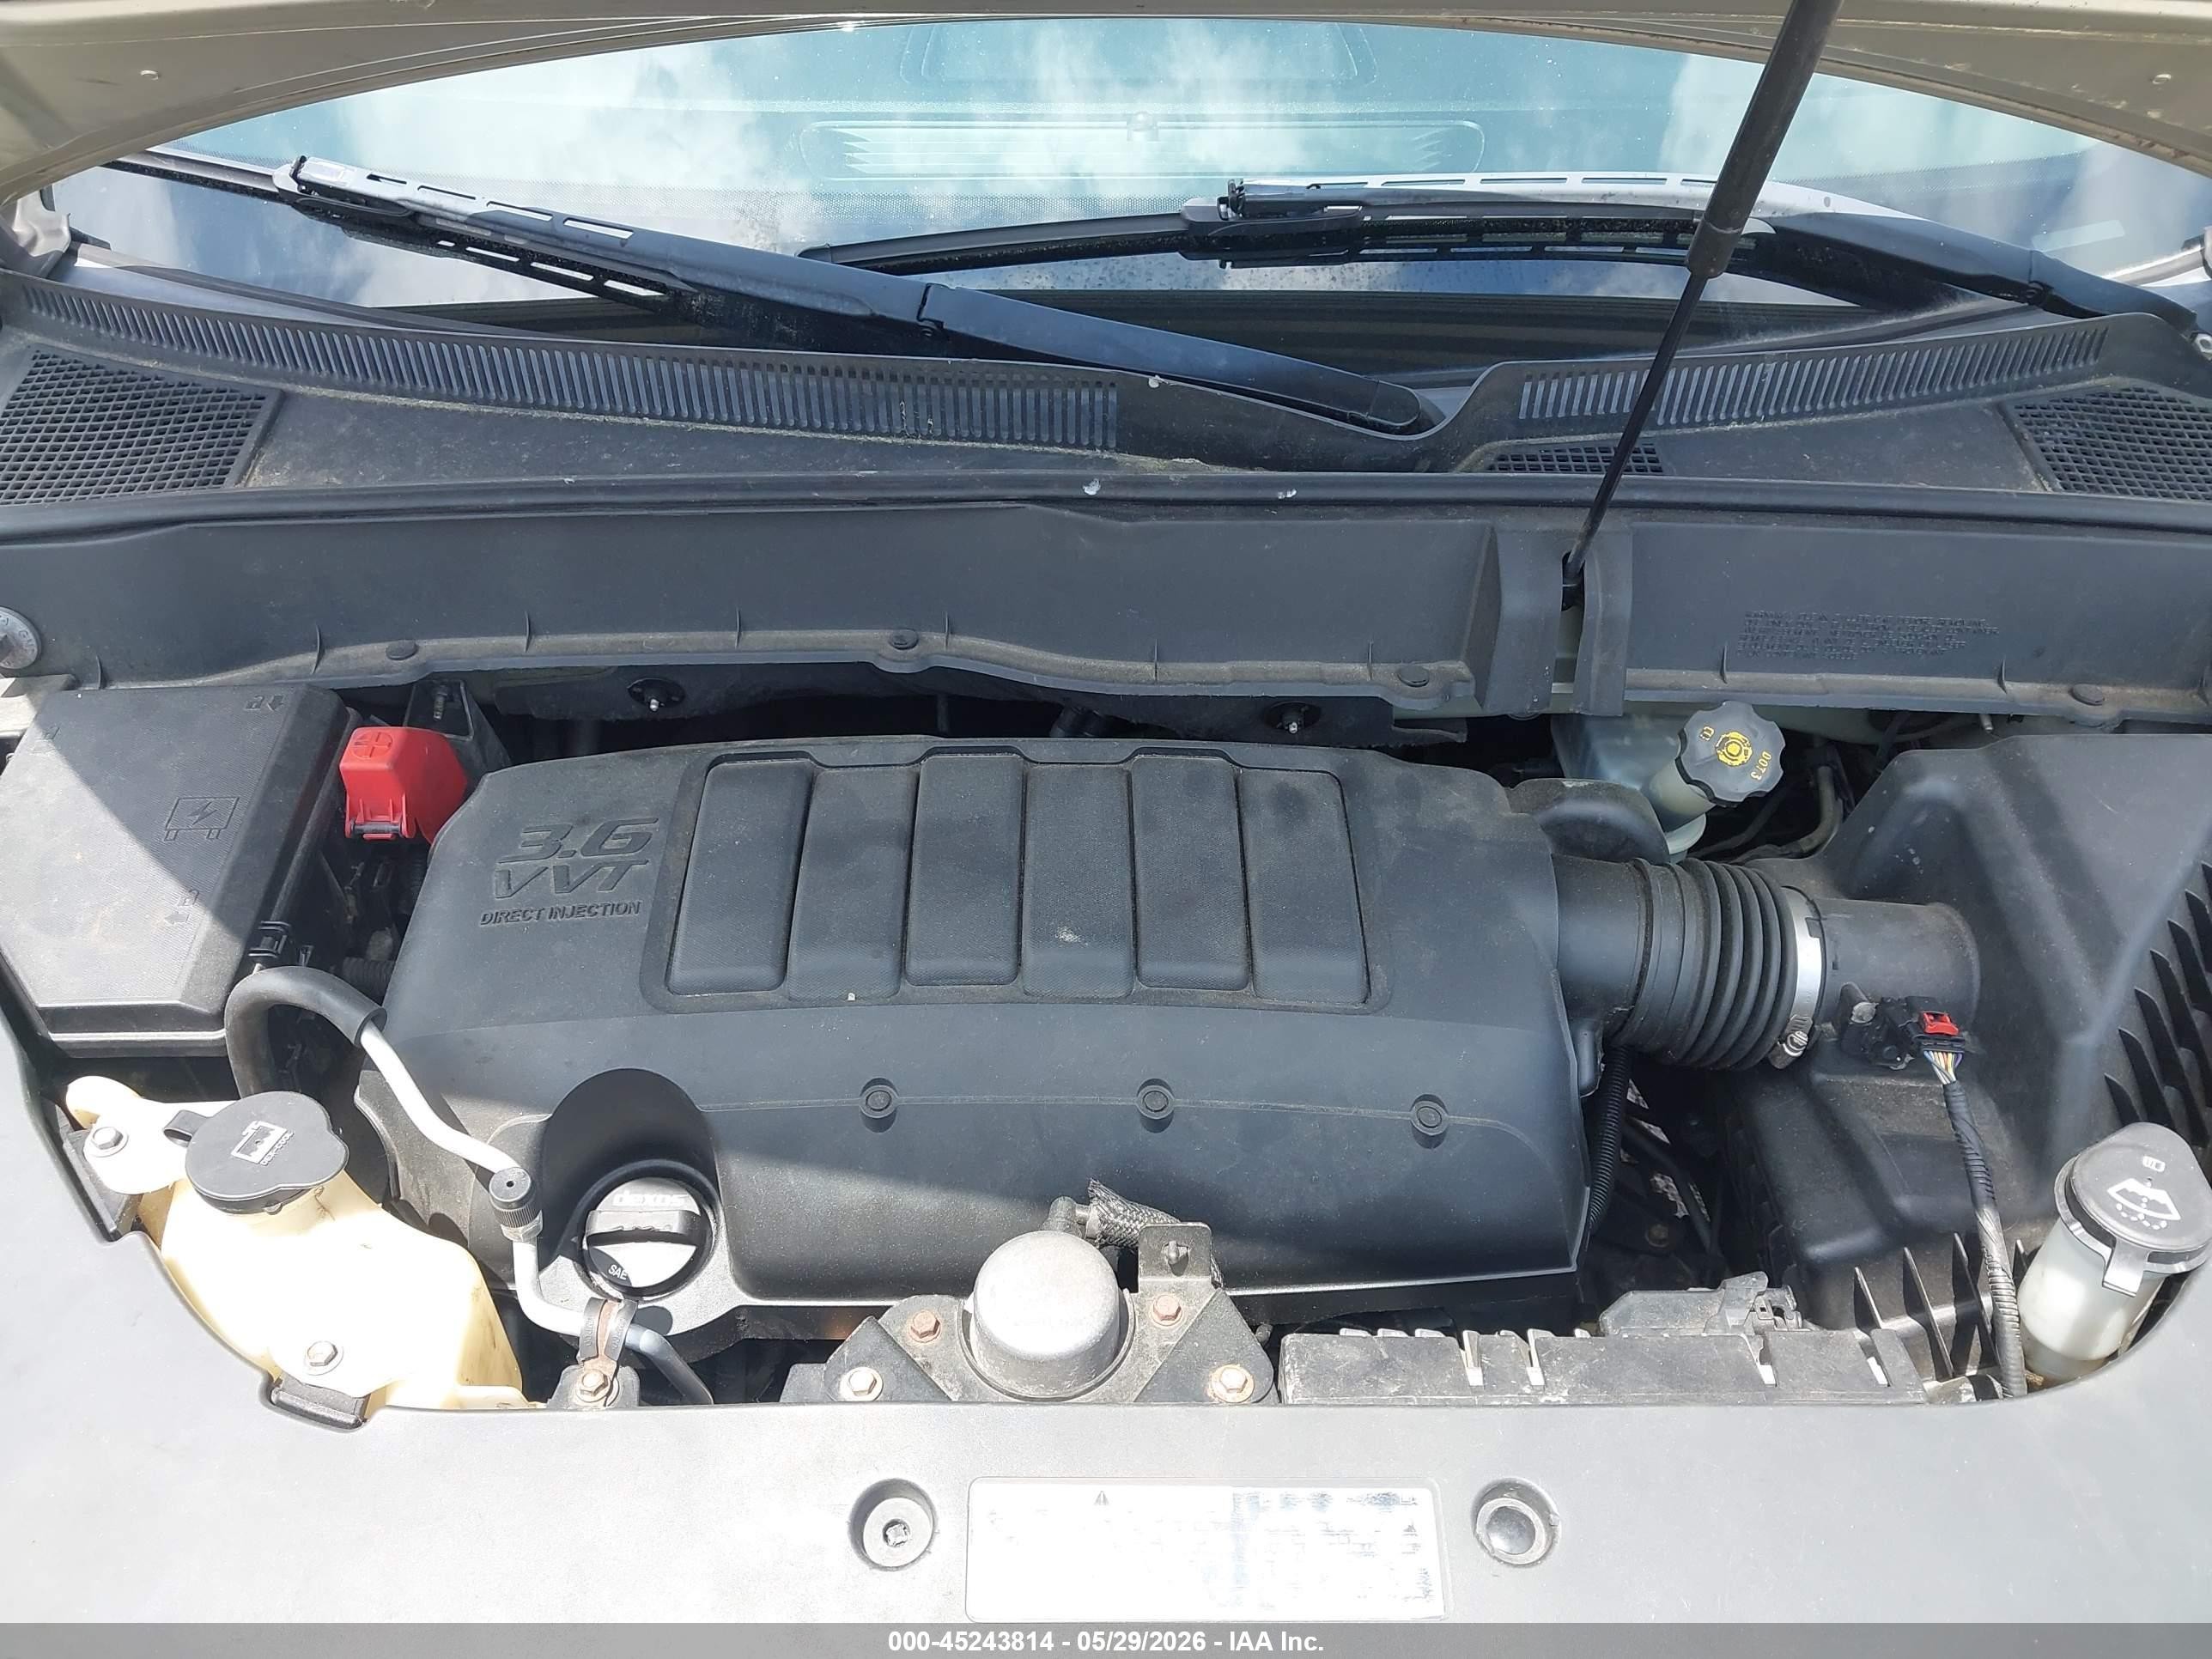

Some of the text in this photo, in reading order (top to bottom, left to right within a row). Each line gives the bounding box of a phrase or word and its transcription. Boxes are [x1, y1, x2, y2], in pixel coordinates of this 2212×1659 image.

[497, 817, 659, 864] 3.6
[494, 860, 650, 899] VVT
[479, 908, 544, 926] DIRECT
[548, 901, 643, 921] INJECTION
[608, 1264, 628, 1280] SAE
